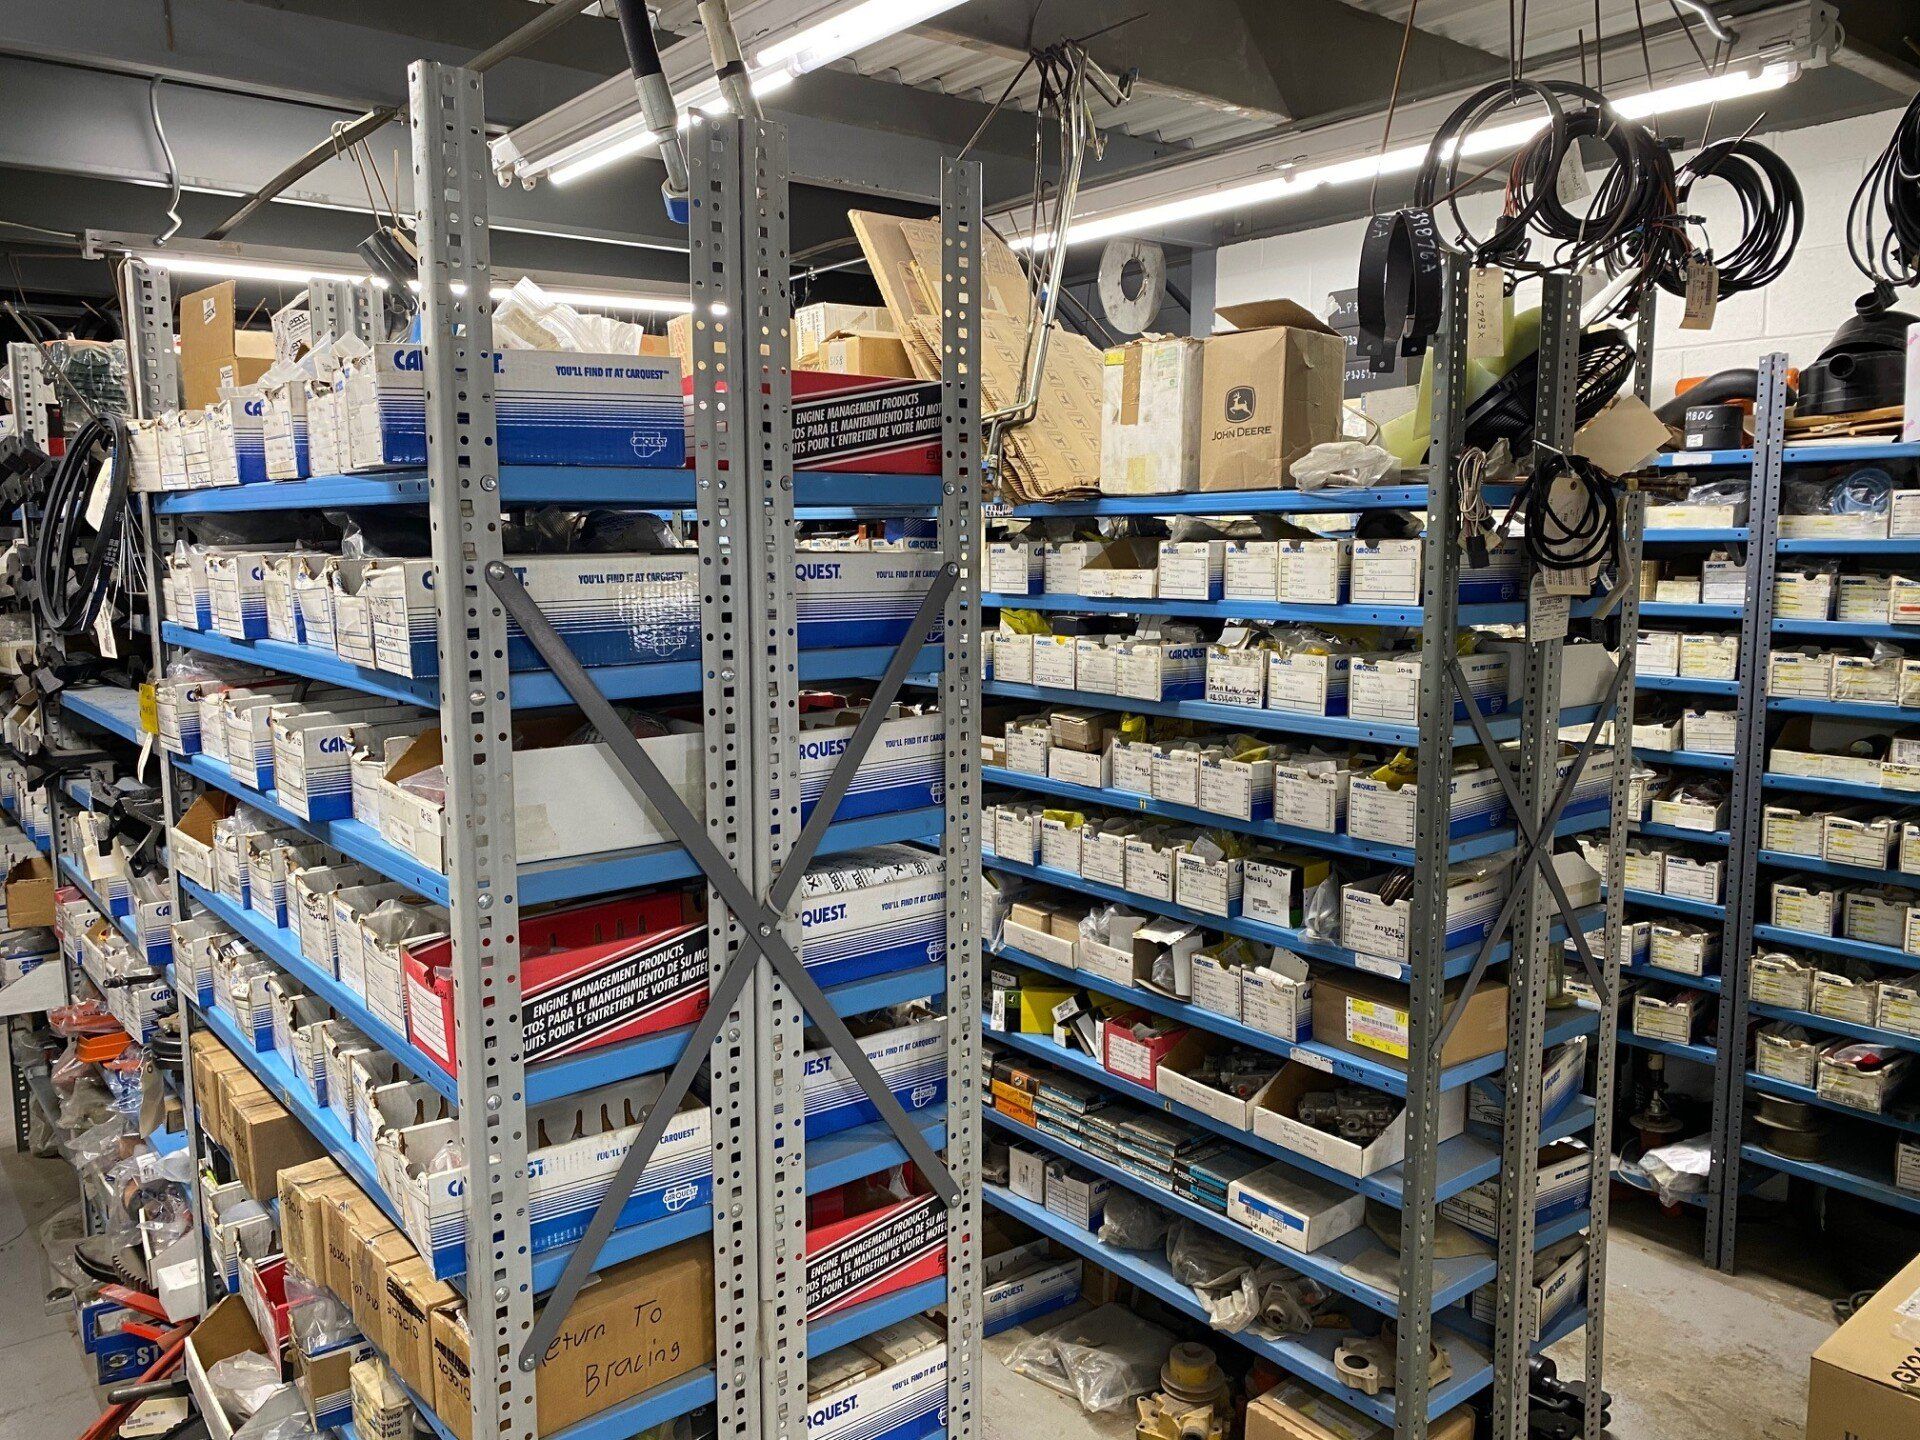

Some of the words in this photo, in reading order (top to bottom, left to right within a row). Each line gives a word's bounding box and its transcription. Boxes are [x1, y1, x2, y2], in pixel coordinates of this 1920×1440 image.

[1339, 301, 1358, 315] LP3
[555, 366, 583, 377] YOU'LL
[584, 367, 604, 378] FIND
[605, 368, 612, 378] IT
[613, 369, 625, 379] AT
[625, 370, 664, 380] CARQUEST
[792, 427, 805, 440] TOS
[807, 423, 829, 438] PARA
[831, 423, 839, 433] EL
[840, 410, 903, 431] MANTENIMIENTO
[905, 407, 913, 419] DE
[915, 405, 926, 418] SU
[926, 402, 942, 416] MOT
[796, 409, 825, 425] ENGINE
[827, 401, 881, 420] MANAGEMENT
[882, 393, 919, 411] PRODUCTS
[807, 438, 829, 451] POUR
[830, 429, 878, 448] L'ENTRETIEN
[880, 426, 889, 438] DE
[891, 422, 914, 437] VOTRE
[1211, 428, 1236, 442] JOHN
[1237, 424, 1272, 438] DEERE
[908, 540, 938, 550] CARQUES
[578, 574, 604, 585] YOU'LL
[606, 573, 625, 583] FIND
[635, 572, 645, 582] AT
[876, 571, 893, 579] YOU'LL
[895, 570, 908, 578] FIND
[908, 570, 914, 578] IT
[914, 570, 921, 578] AT
[882, 902, 899, 911] YOU'LL
[901, 898, 913, 908] FIND
[914, 897, 919, 905] IT
[920, 895, 926, 904] AT
[523, 1017, 545, 1038] CTOS
[547, 1006, 574, 1028] PARA
[576, 1002, 586, 1015] EL
[588, 967, 665, 1008] MANTENIMIENTO
[667, 960, 679, 975] DE
[680, 954, 692, 970] SU
[694, 947, 708, 964] MO
[533, 995, 569, 1019] ENGINE
[571, 964, 638, 1003] MANAGEMENT
[638, 943, 685, 974] PRODUCTS
[549, 1022, 575, 1042] POUR
[577, 995, 634, 1031] L'ENTRETIEN
[637, 988, 649, 1003] DE
[651, 972, 679, 996] VOTRE
[885, 1046, 898, 1056] FIND
[905, 1043, 911, 1051] AT
[912, 1036, 938, 1050] CARQUEST
[659, 1127, 695, 1144] CARQUEST
[664, 1186, 698, 1203] CARQUEST
[806, 1277, 820, 1293] TOS
[821, 1267, 842, 1286] PARA
[844, 1262, 852, 1274] EL
[853, 1230, 914, 1270] MANTENIMIENTO
[915, 1223, 924, 1235] DE
[926, 1217, 935, 1230] SU
[811, 1254, 839, 1279] ENGINE
[840, 1228, 892, 1262] MANAGEMENT
[893, 1206, 930, 1234] PRODUCTS
[822, 1279, 842, 1298] POUR
[844, 1255, 890, 1285] L'ENTRETIEN
[891, 1248, 901, 1260] DE
[902, 1234, 925, 1254] VOTRE
[542, 1323, 606, 1367] eturn
[634, 1300, 662, 1327] To
[585, 1339, 681, 1398] Bracing
[892, 1379, 910, 1392] YOU'LL
[911, 1373, 923, 1385] FIND
[924, 1370, 929, 1379] IT
[929, 1366, 937, 1376] AT
[937, 1360, 948, 1372] CAR
